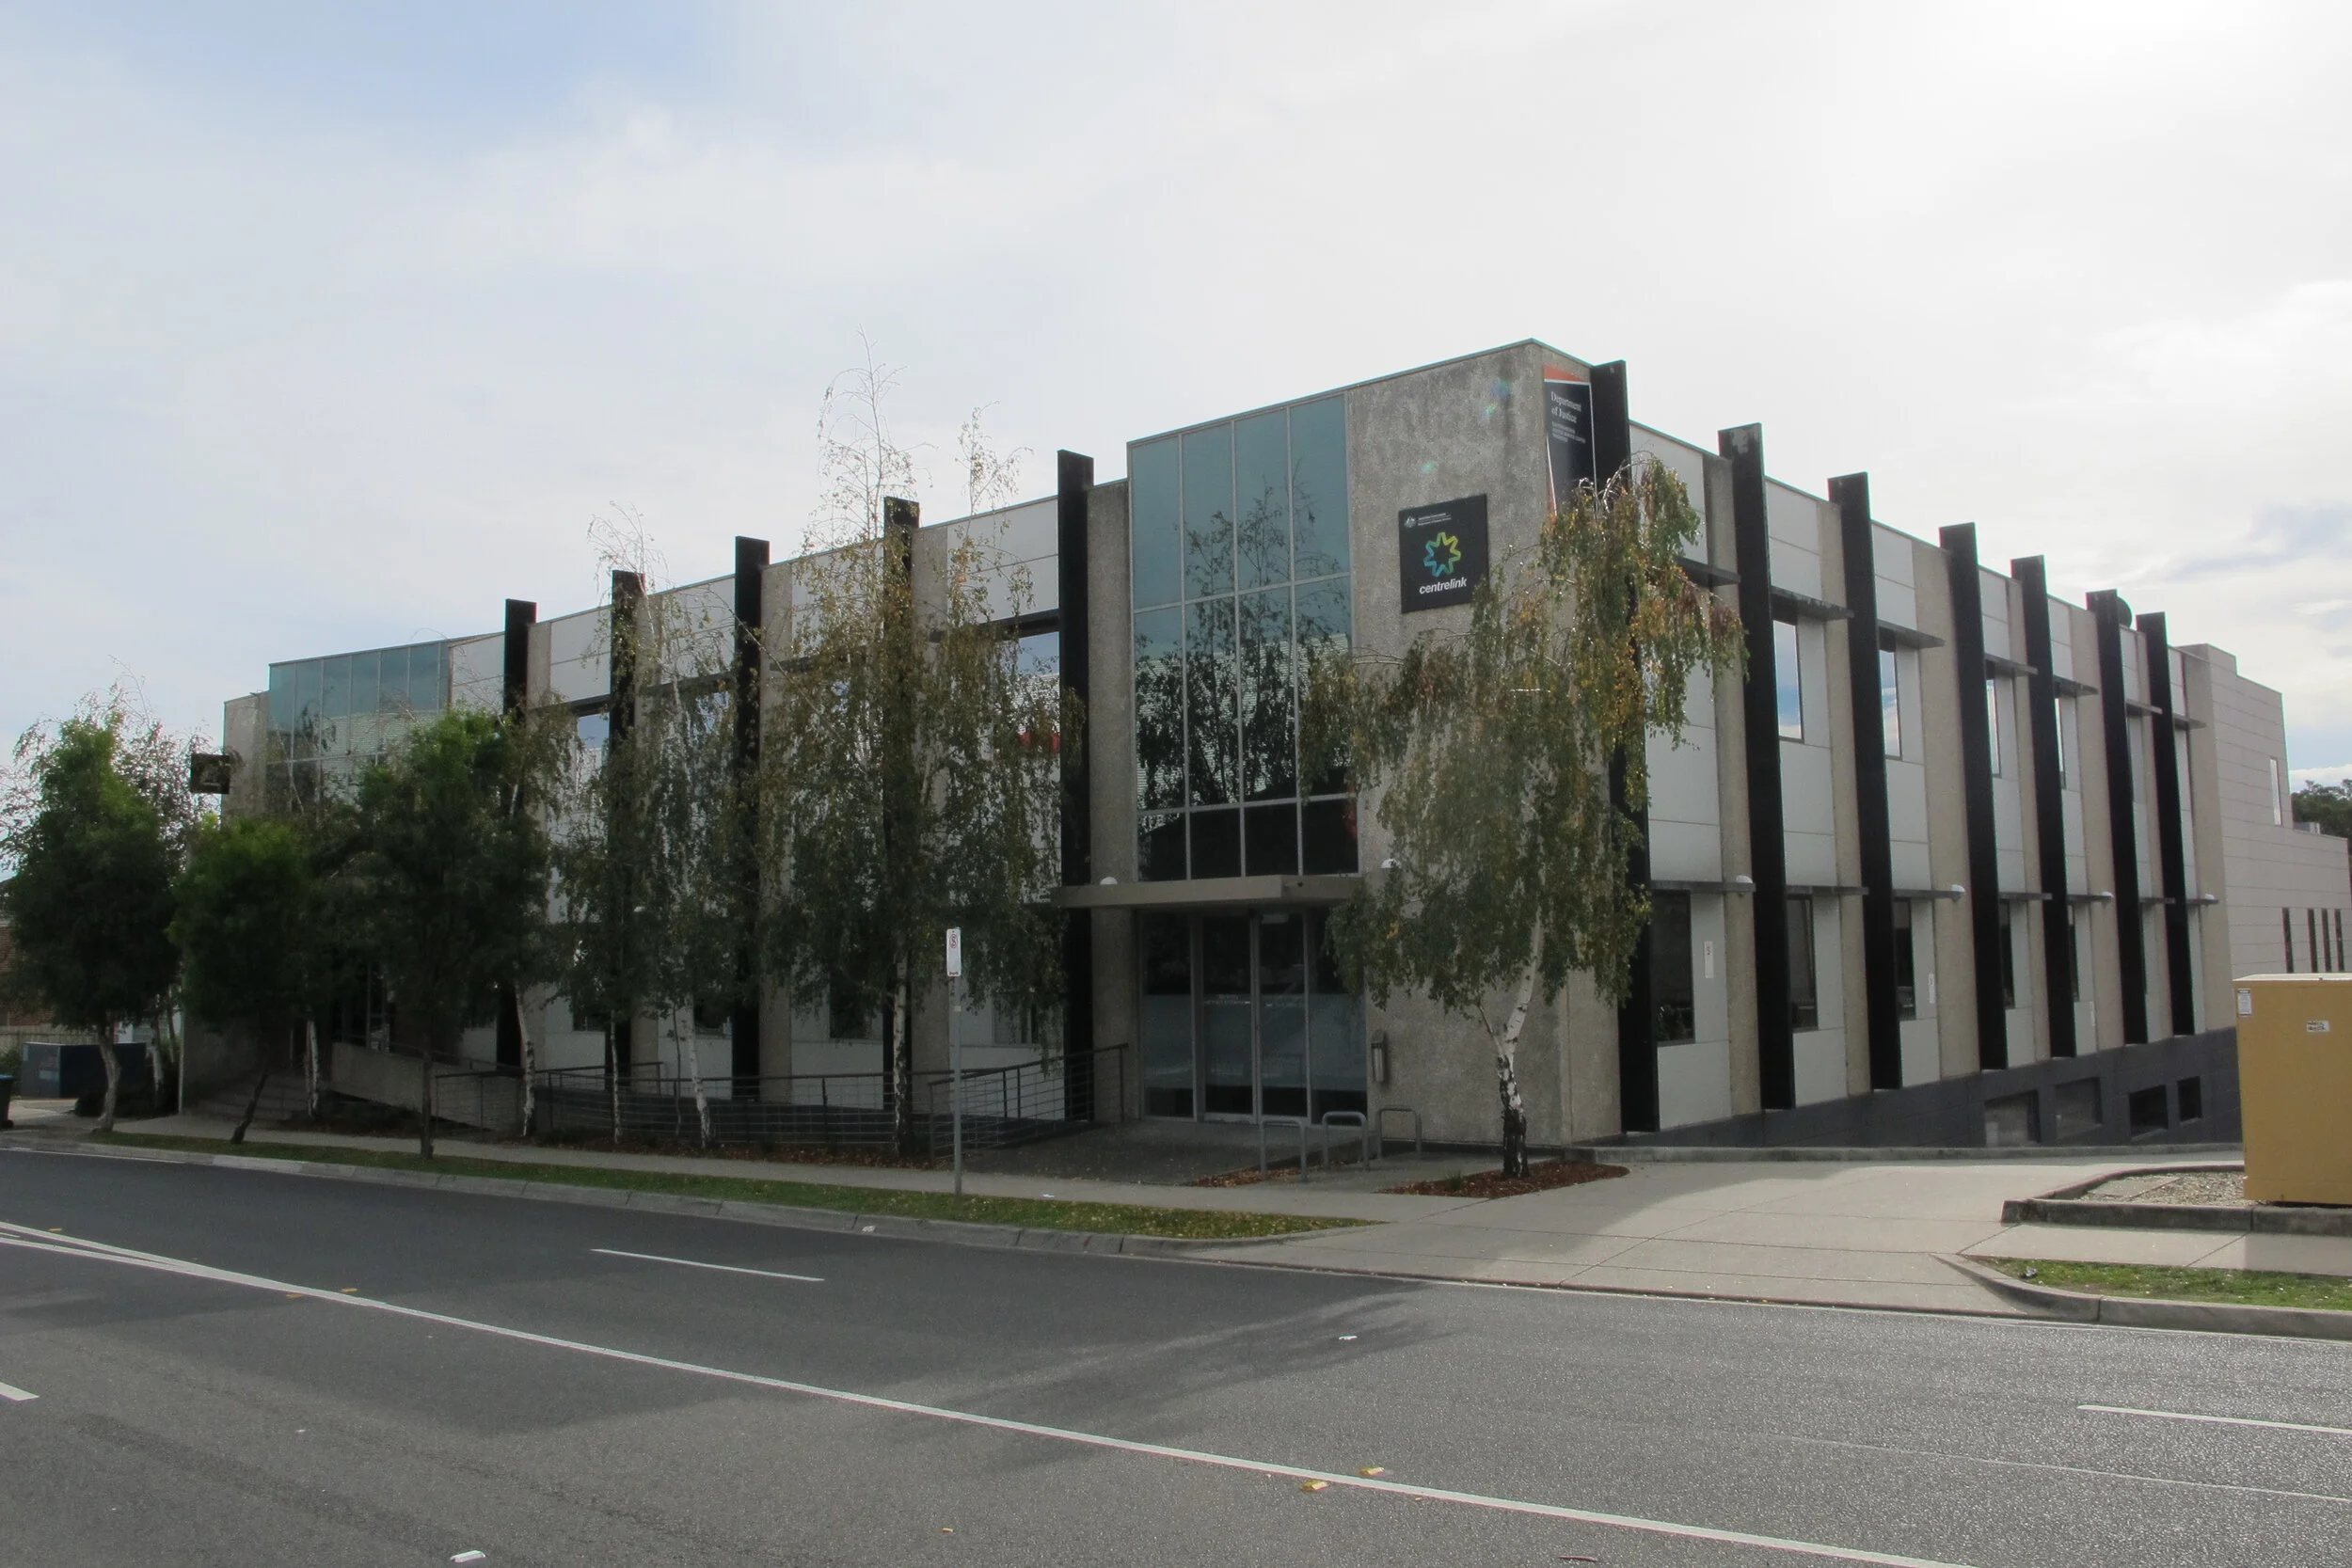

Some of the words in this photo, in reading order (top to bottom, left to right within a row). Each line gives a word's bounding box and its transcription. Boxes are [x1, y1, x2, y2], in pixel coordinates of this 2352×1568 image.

[1551, 391, 1581, 412] Department
[1551, 406, 1558, 416] of
[1559, 408, 1577, 423] Justice
[1419, 577, 1468, 594] centrelink
